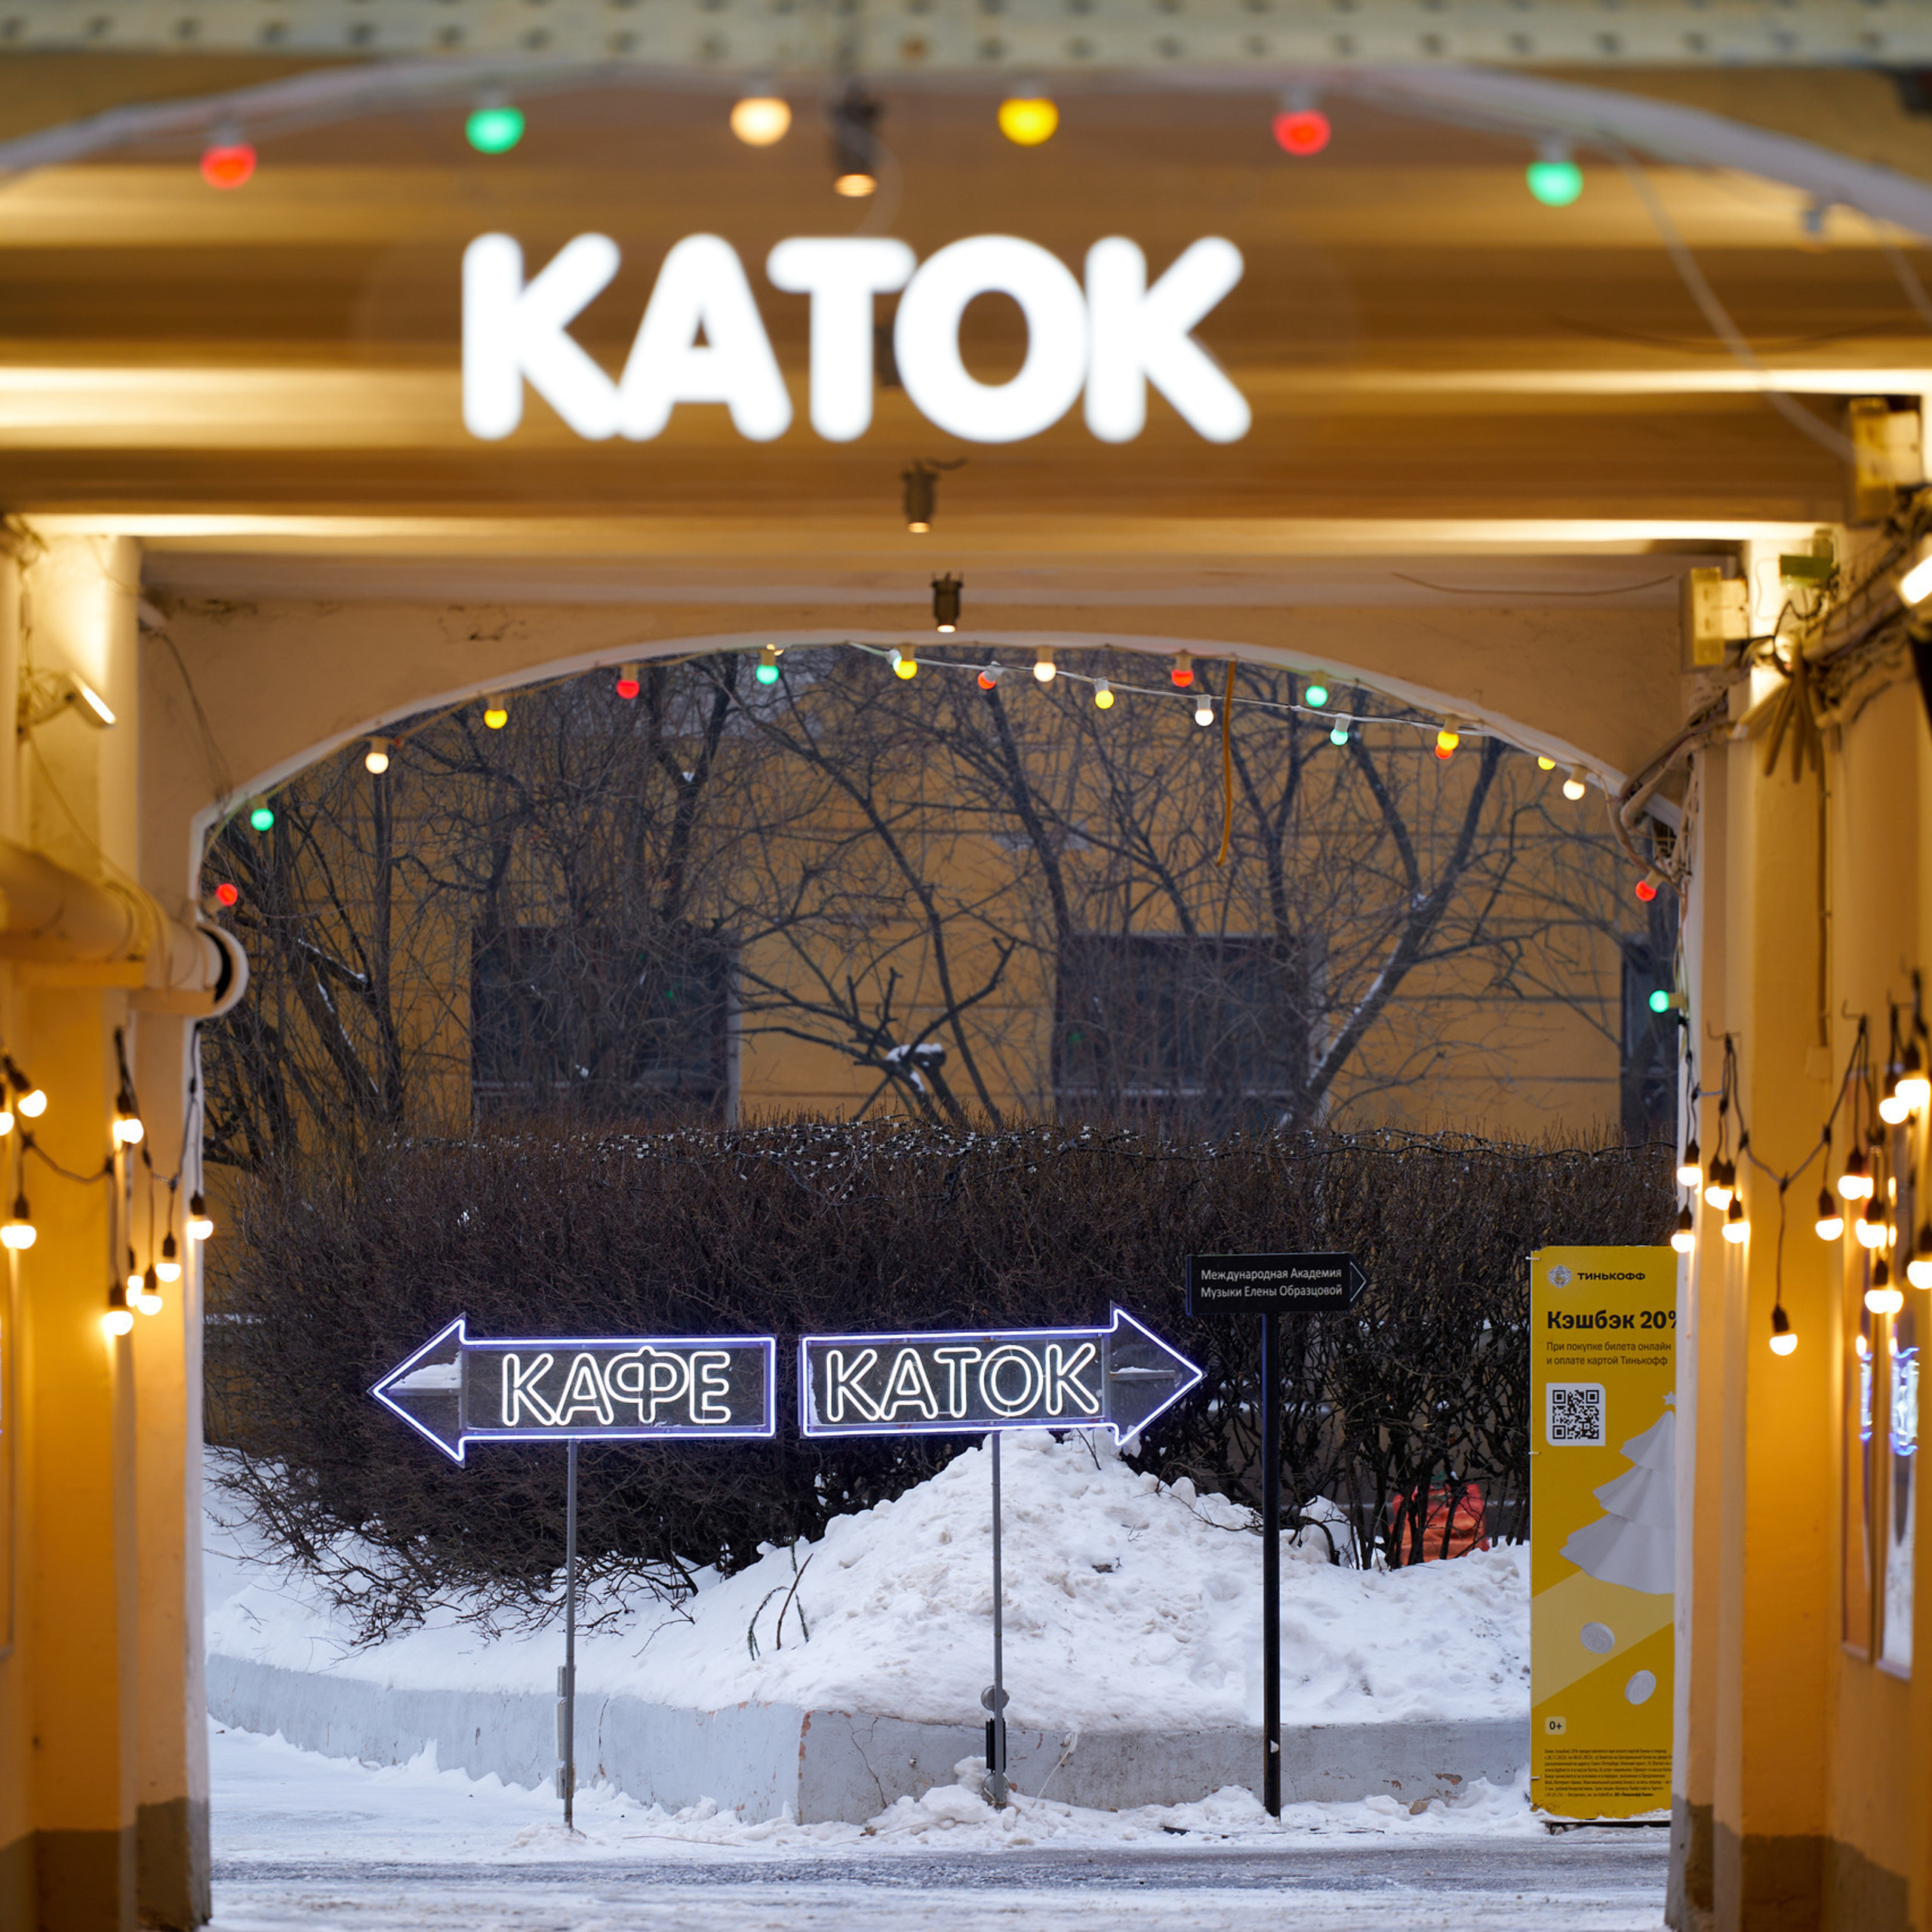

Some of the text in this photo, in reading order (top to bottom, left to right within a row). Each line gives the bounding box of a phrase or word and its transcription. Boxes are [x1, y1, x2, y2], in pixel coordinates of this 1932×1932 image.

[460, 232, 1253, 445] КАТОК
[1201, 1268, 1342, 1281] Международная Академия
[1201, 1284, 1343, 1300] Музыки Елены Образцовой
[1547, 1309, 1635, 1329] Кэшбэк
[1546, 1342, 1672, 1352] При покупке билета онлайн
[1587, 1356, 1618, 1367] картой
[1620, 1356, 1668, 1367] Тинькофф
[502, 1345, 731, 1426] КАФЕ
[826, 1342, 1100, 1423] КАТОК
[1549, 1721, 1562, 1730] 0+
